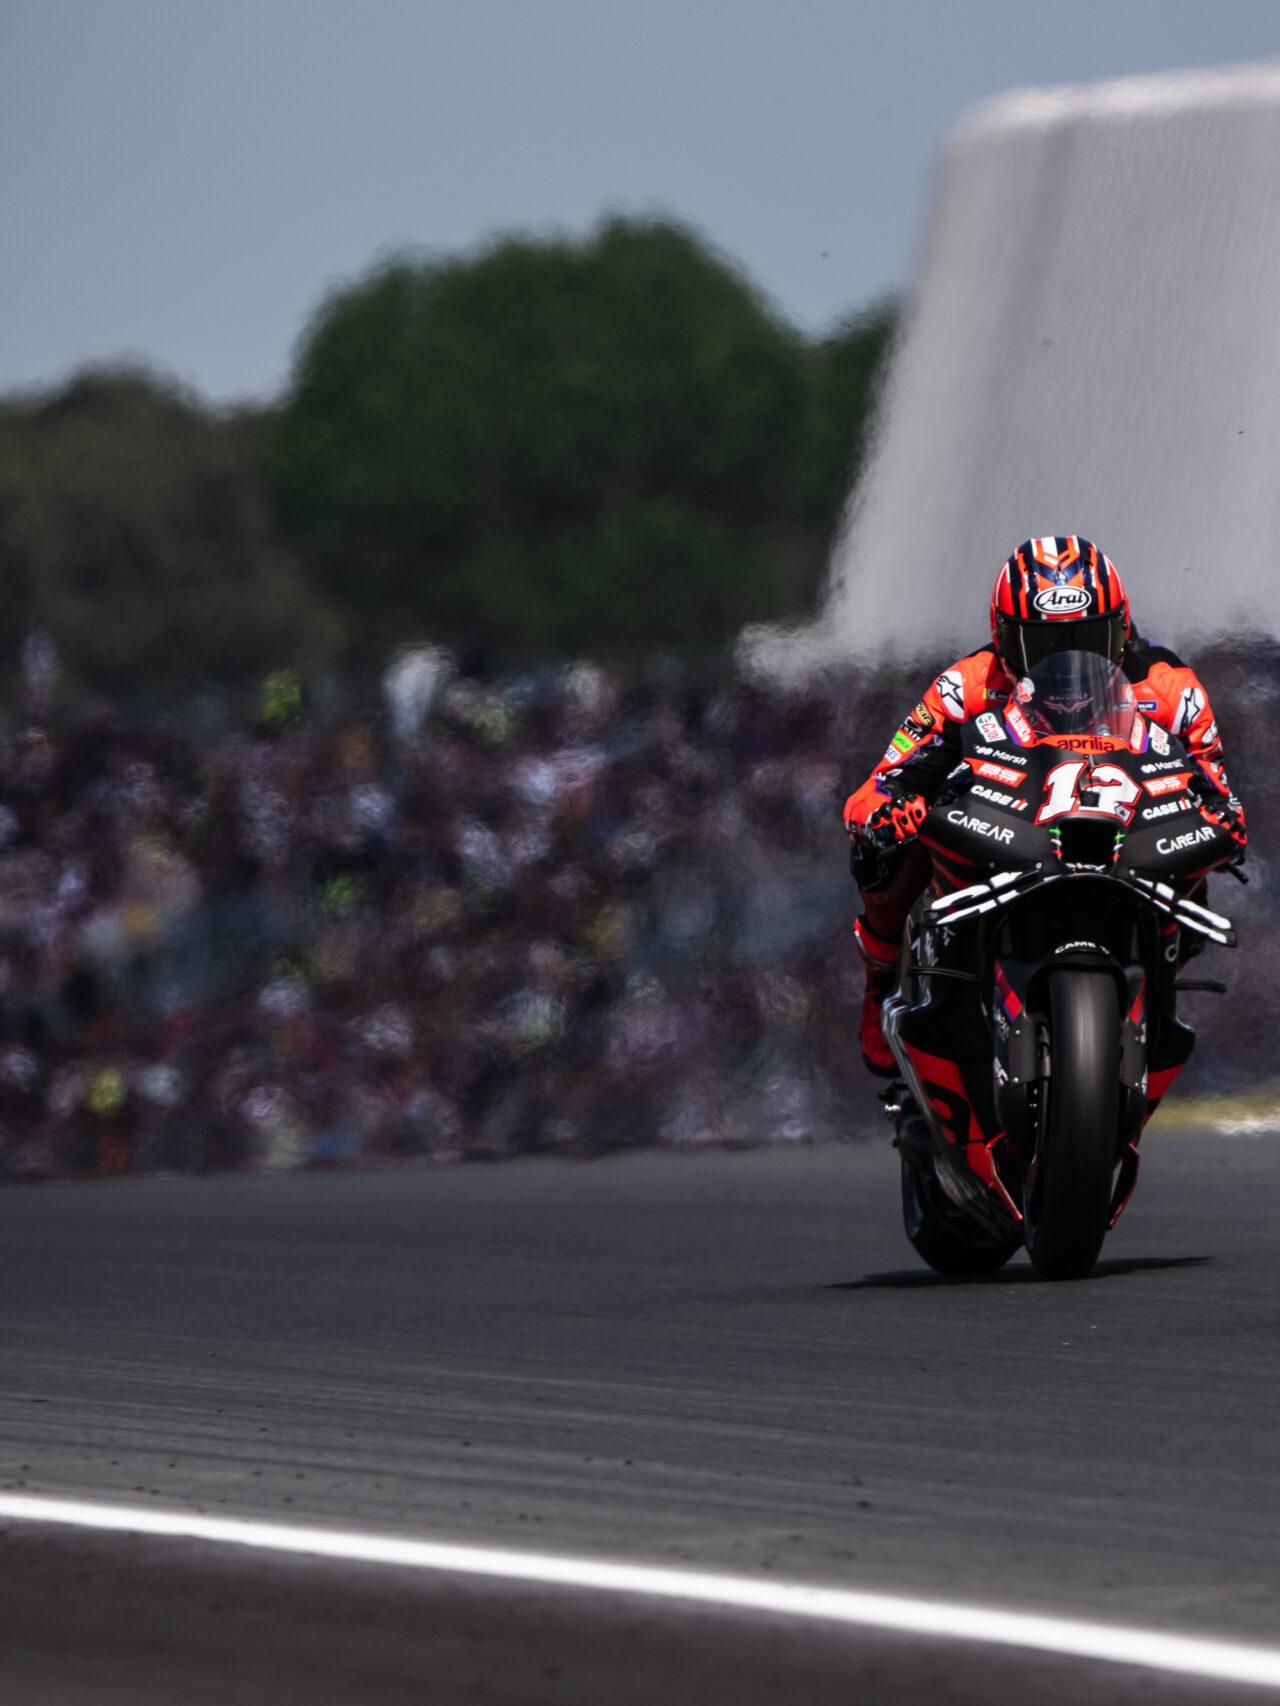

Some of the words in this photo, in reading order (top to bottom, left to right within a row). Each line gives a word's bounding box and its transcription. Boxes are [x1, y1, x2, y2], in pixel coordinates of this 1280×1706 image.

[1047, 590, 1083, 606] Arai
[1057, 736, 1115, 752] aprilia
[993, 750, 1028, 766] Marsh
[970, 785, 1013, 806] CASE
[1034, 760, 1142, 827] 12
[1142, 801, 1180, 820] CASE
